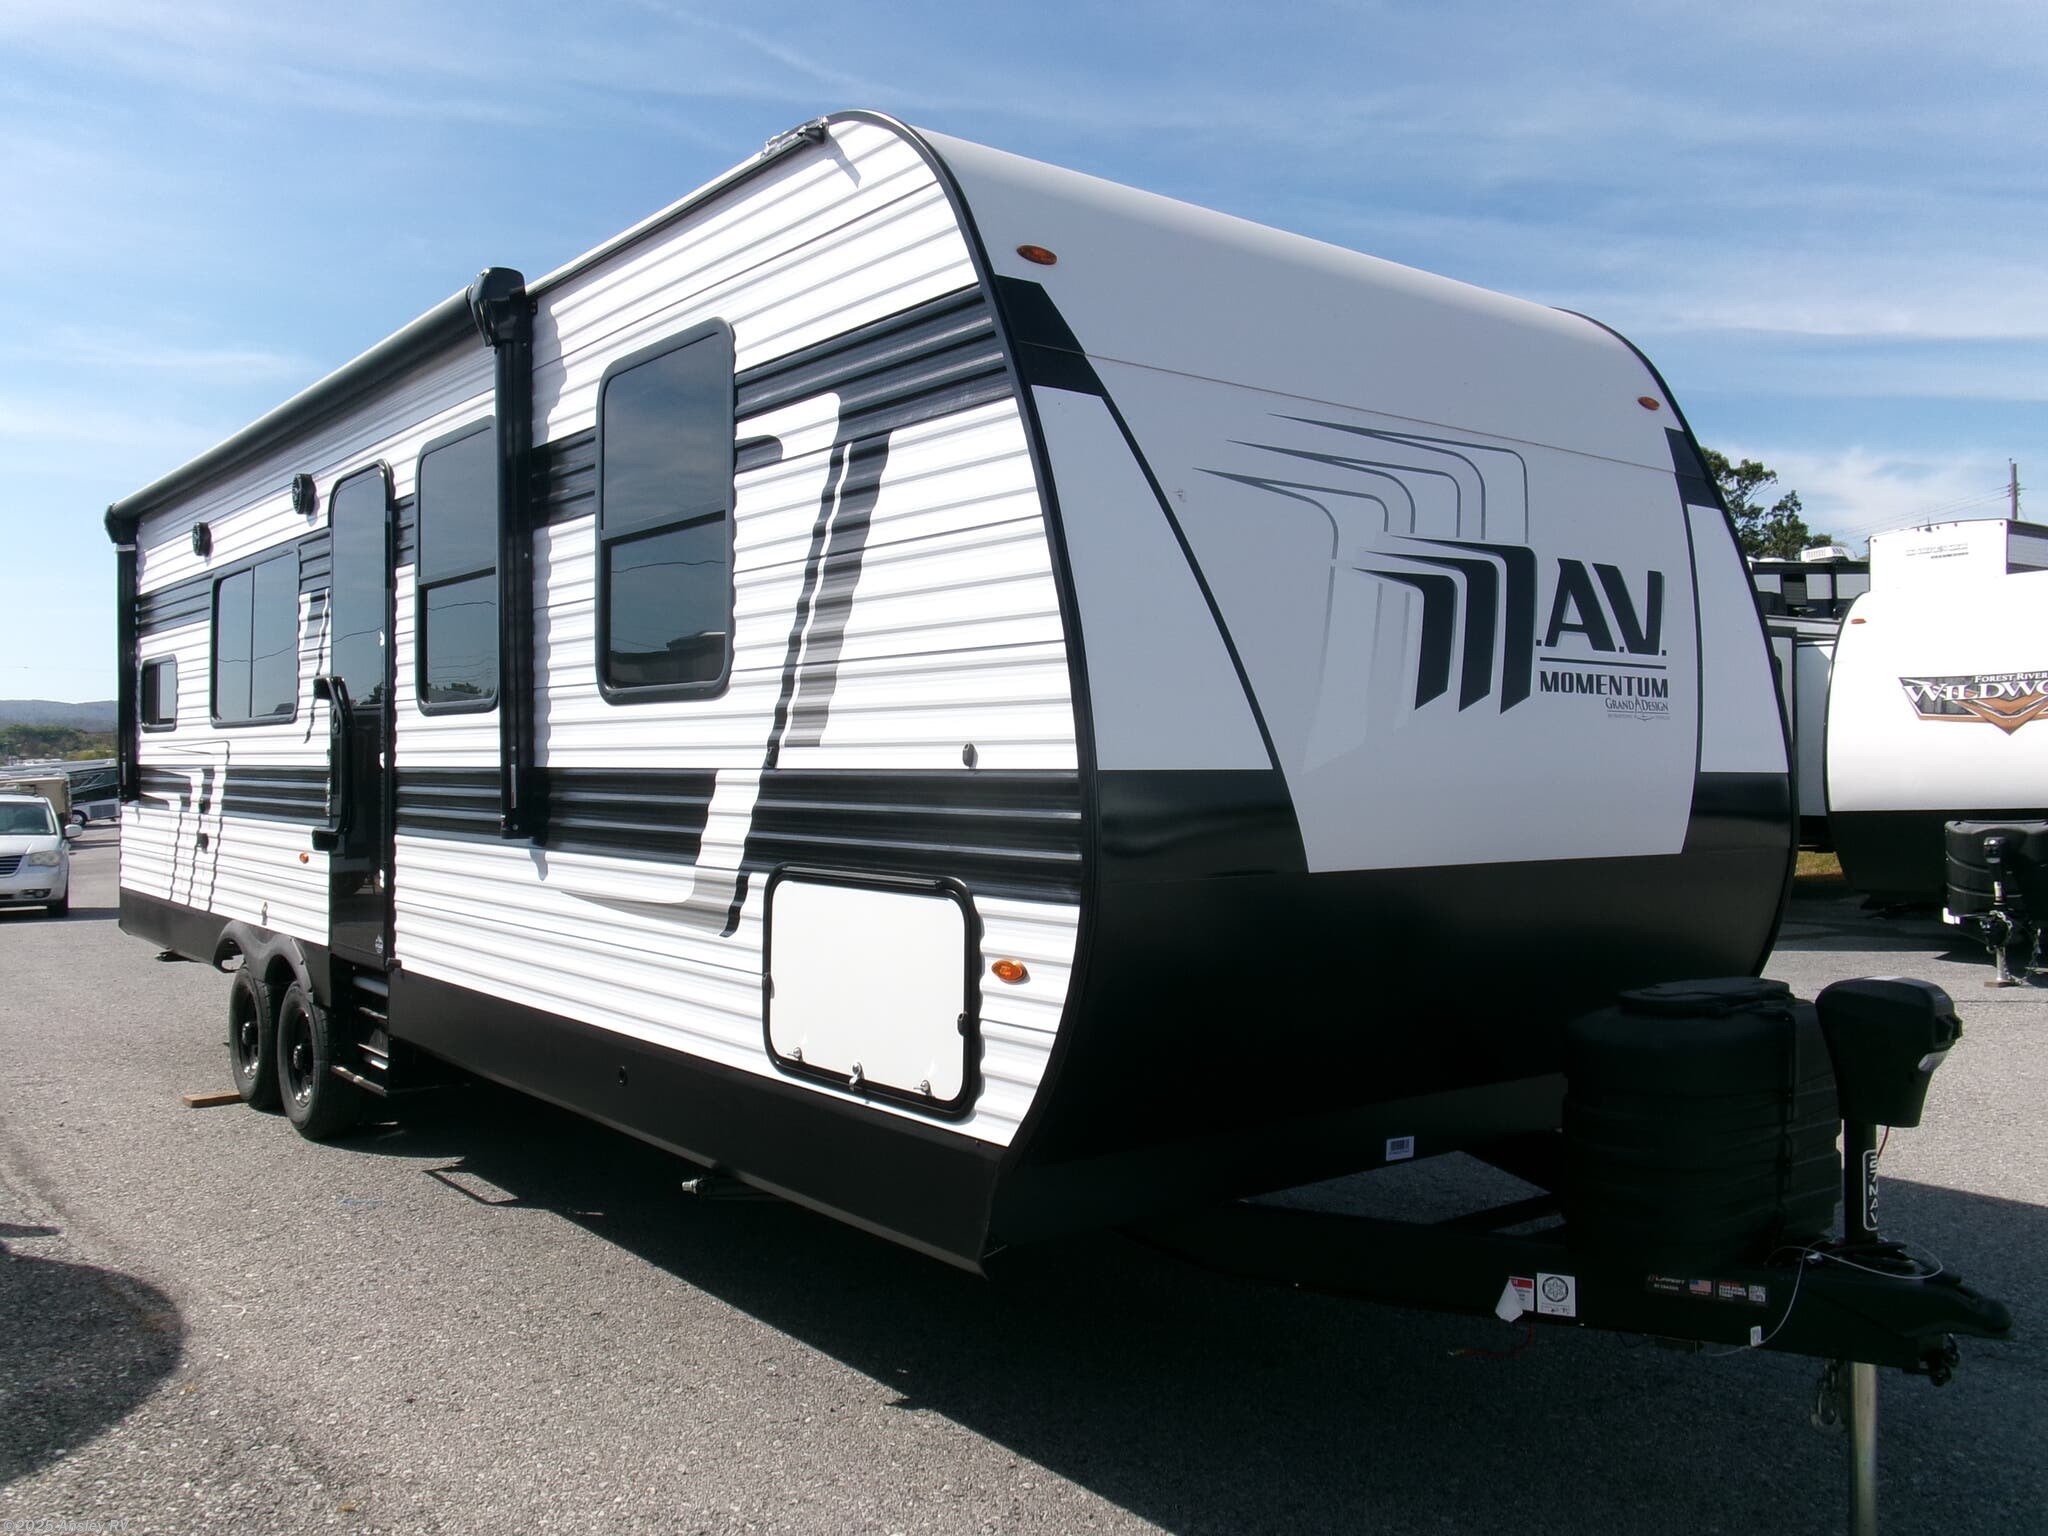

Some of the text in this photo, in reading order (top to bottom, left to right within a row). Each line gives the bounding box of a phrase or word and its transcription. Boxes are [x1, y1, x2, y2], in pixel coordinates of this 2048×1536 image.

[1539, 670, 1669, 699] MOMENTUM
[1975, 672, 2048, 684] FOREST RIVER
